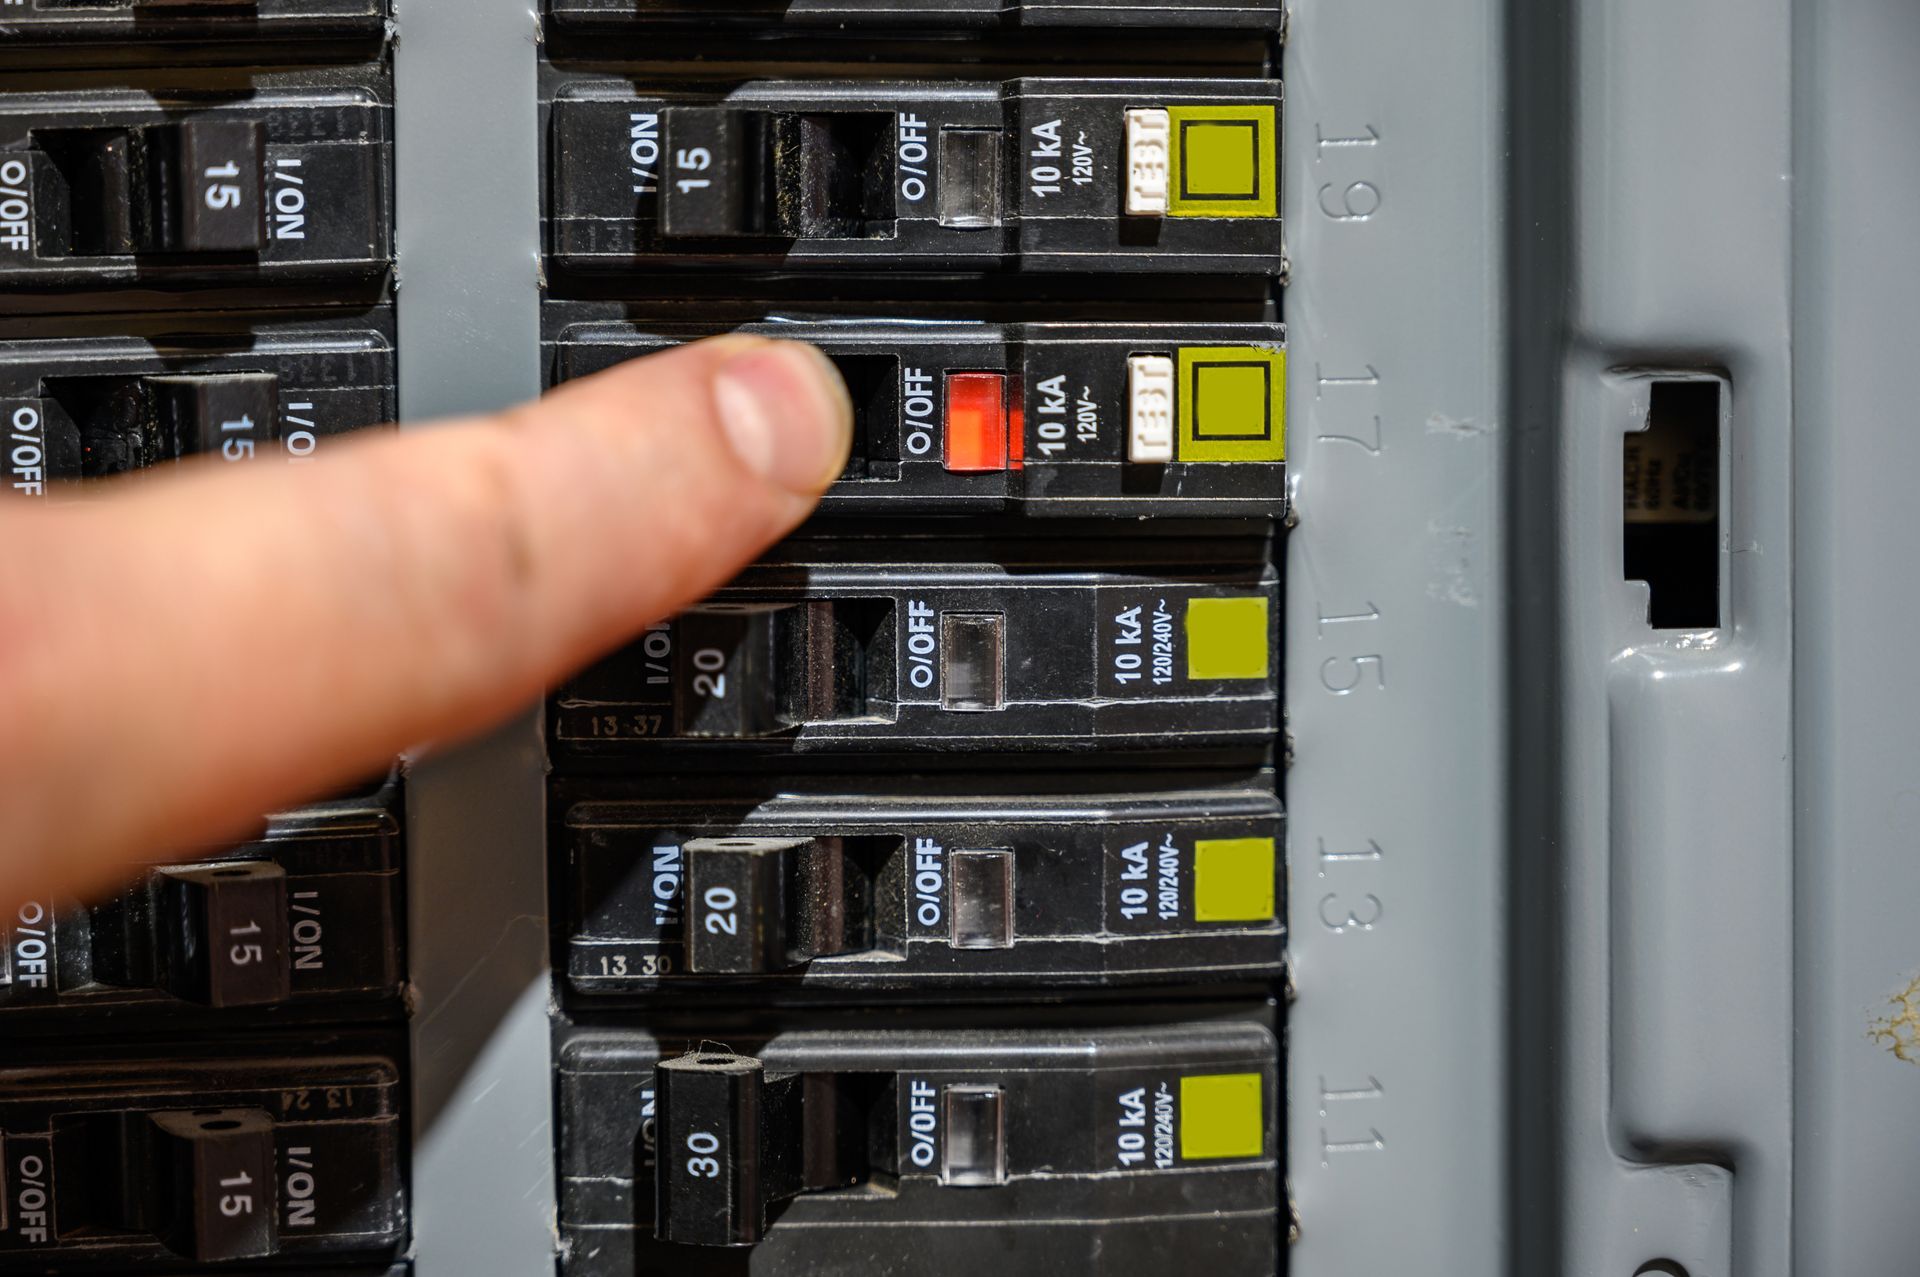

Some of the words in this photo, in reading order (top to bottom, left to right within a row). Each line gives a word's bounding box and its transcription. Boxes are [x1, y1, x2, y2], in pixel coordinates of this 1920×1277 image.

[630, 113, 659, 193] I/ON
[676, 147, 711, 194] 15
[899, 112, 928, 201] O/OFF
[1030, 119, 1062, 157] kA
[1317, 122, 1383, 223] 19
[0, 160, 30, 251] O/OFF
[204, 160, 241, 210] 15
[274, 158, 305, 240] I/ON
[1030, 166, 1062, 198] 10
[903, 367, 934, 455] O/OFF
[1036, 374, 1067, 414] kA
[1137, 363, 1169, 454] TEST
[1315, 363, 1379, 456] 17
[11, 406, 42, 496] O/OFF
[220, 413, 256, 462] 15
[1037, 422, 1066, 456] 10
[907, 599, 935, 689] O/OFF
[1114, 605, 1142, 645] kA
[1315, 601, 1386, 697] 15
[693, 649, 727, 699] 20
[1114, 653, 1142, 685] 10
[652, 845, 680, 926] I/ON
[914, 837, 943, 926] O/OFF
[1120, 841, 1149, 881] kA
[1316, 835, 1386, 934] 13
[229, 920, 263, 966] 15
[291, 891, 324, 970] I/ON
[704, 887, 737, 936] 20
[1120, 887, 1149, 920] 10
[16, 902, 47, 988] O/OFF
[601, 956, 629, 976] 13
[909, 1080, 936, 1167] O/OFF
[1118, 1087, 1146, 1127] kA
[1318, 1075, 1385, 1168] 11
[286, 1146, 316, 1226] I/ON
[686, 1132, 720, 1178] 30
[1117, 1133, 1146, 1166] 10
[18, 1155, 48, 1243] O/OFF
[219, 1171, 253, 1217] 15
